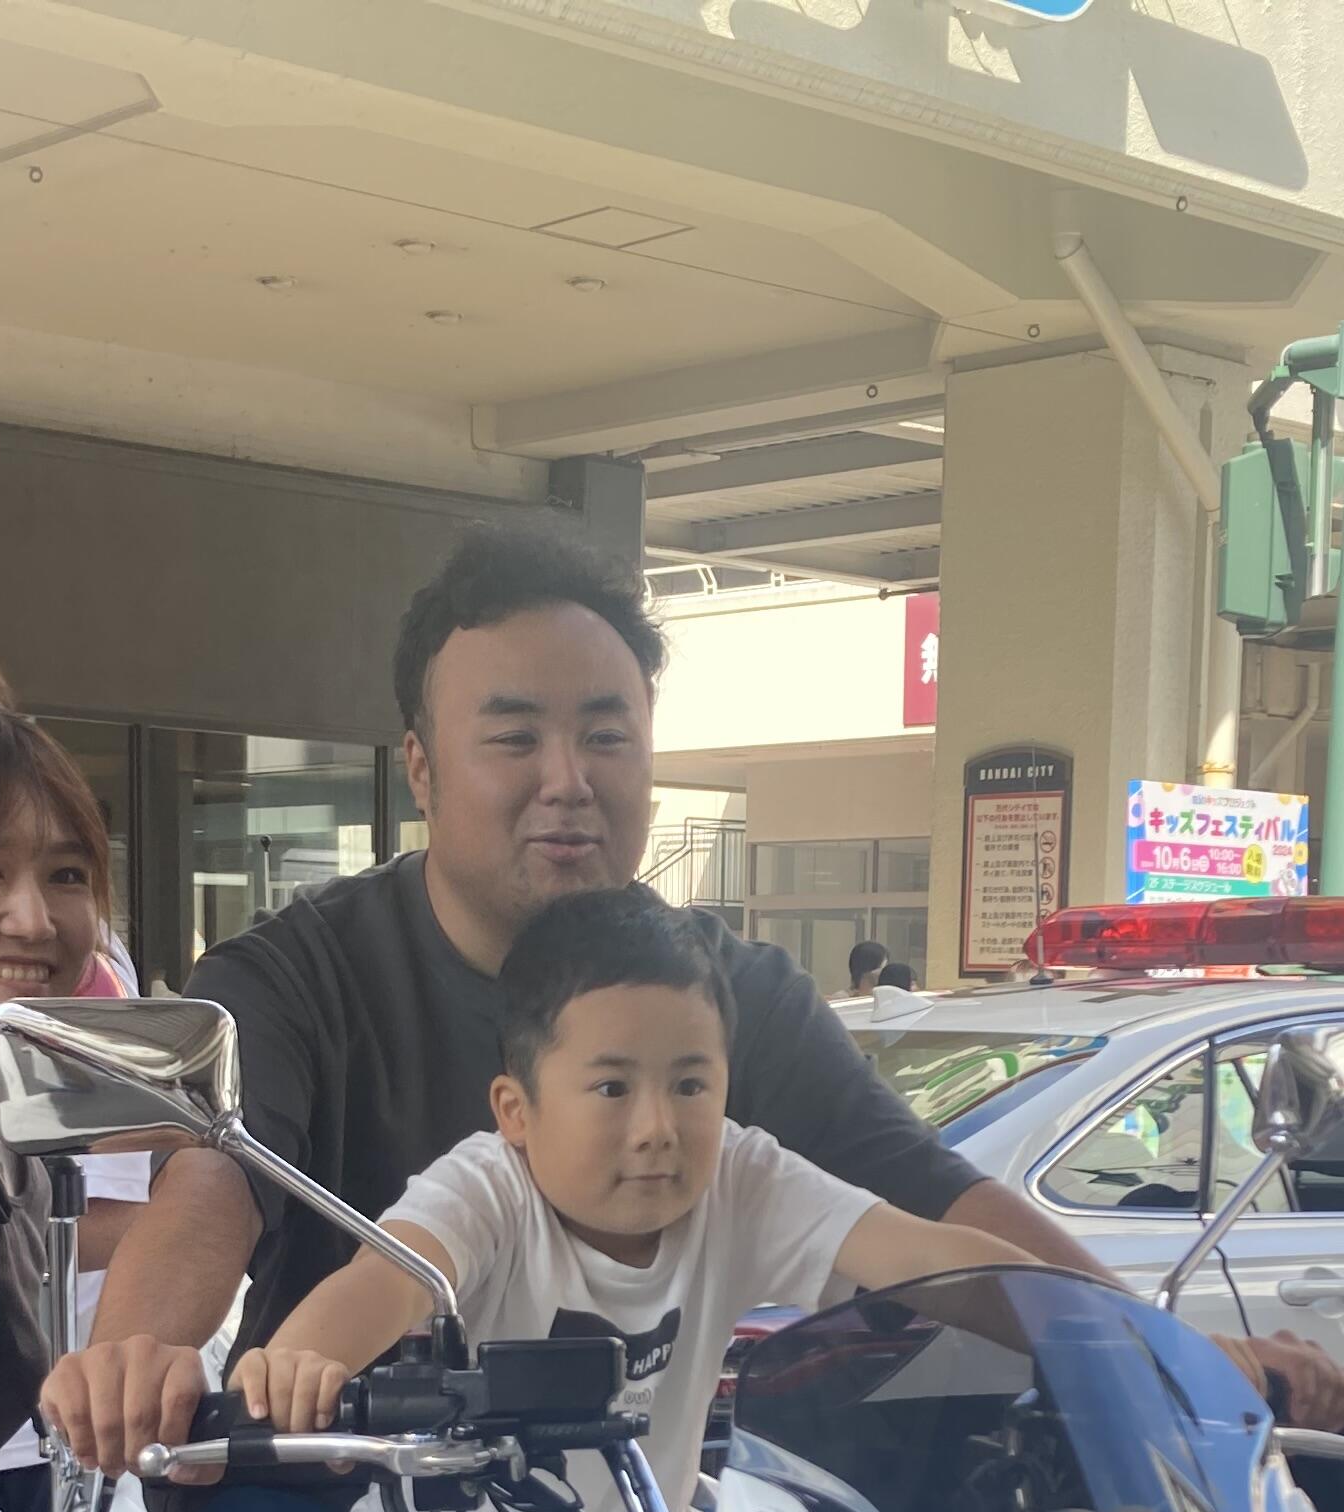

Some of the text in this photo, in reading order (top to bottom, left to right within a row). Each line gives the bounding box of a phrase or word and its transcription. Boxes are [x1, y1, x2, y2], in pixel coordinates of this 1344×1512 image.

[1027, 765, 1055, 778] CITY
[1149, 808, 1297, 842] キッズフェスティバル
[633, 1343, 672, 1375] HAPP
